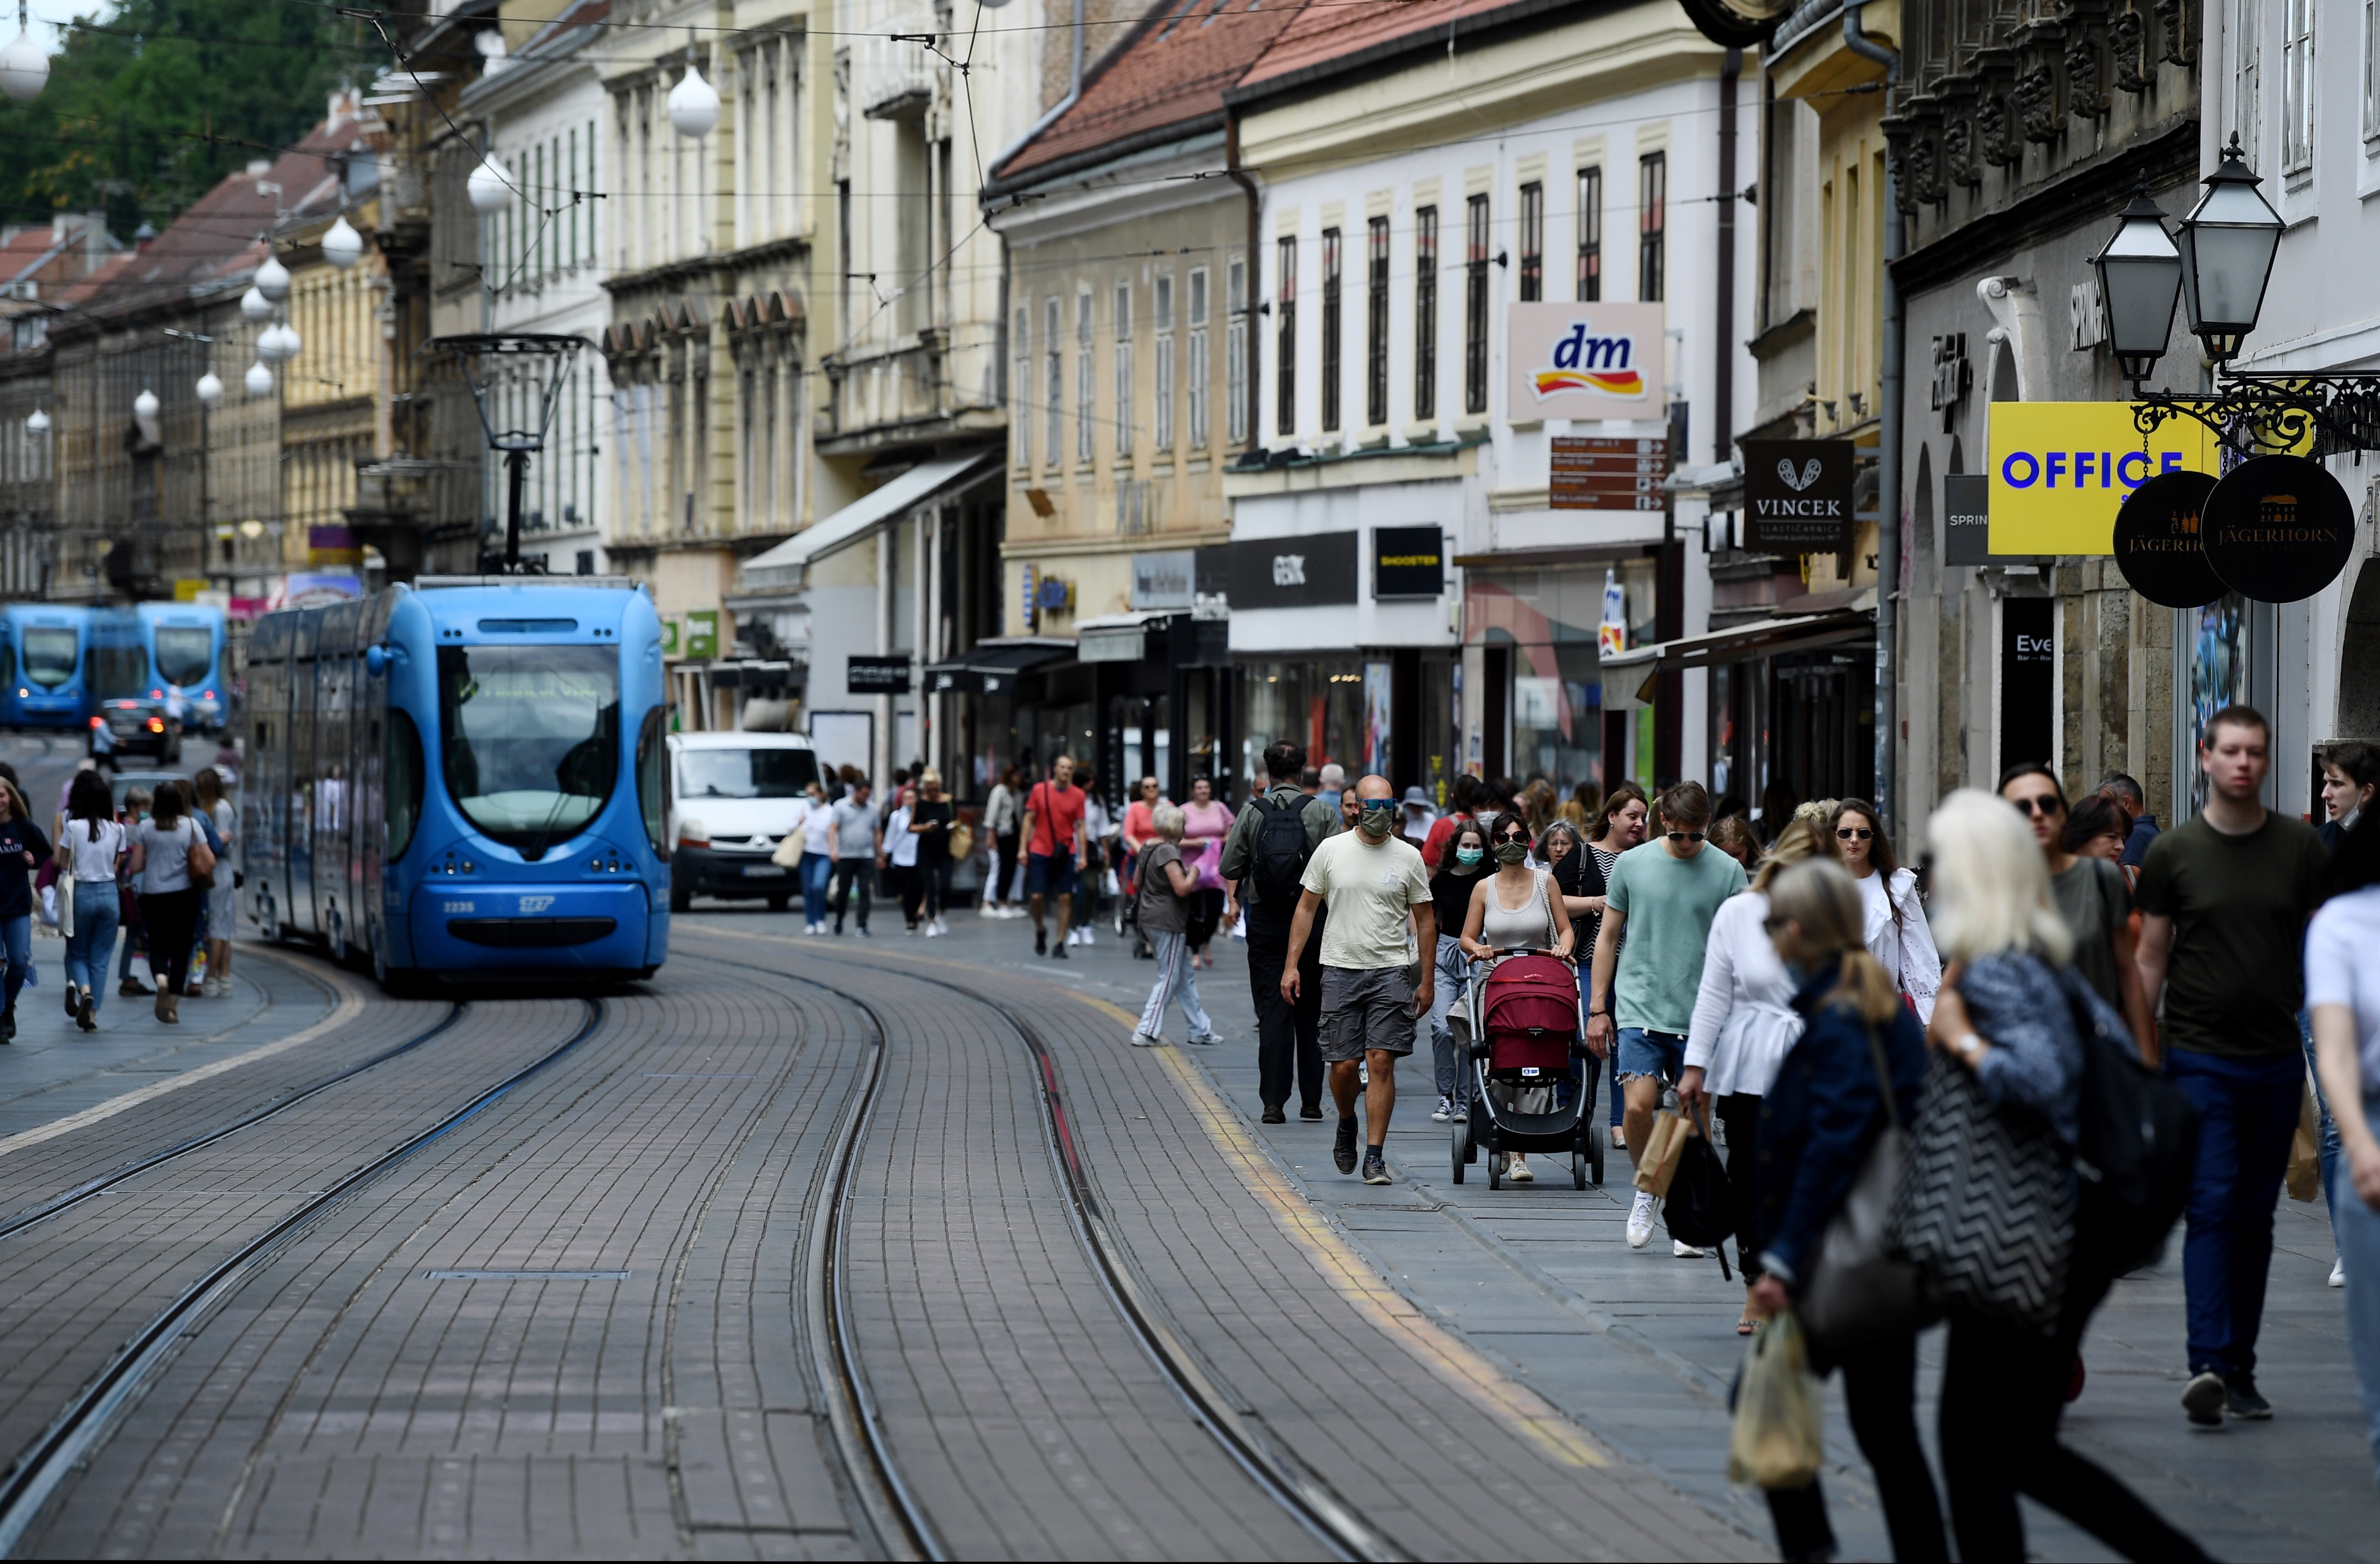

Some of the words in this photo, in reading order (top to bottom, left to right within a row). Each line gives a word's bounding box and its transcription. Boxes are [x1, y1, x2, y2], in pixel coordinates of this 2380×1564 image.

[1554, 324, 1630, 368] dm
[2002, 452, 2182, 489] OFFICE
[1756, 499, 1841, 516] VINCEK
[1950, 515, 1987, 526] SPRIN
[2218, 525, 2338, 546] JÄGERHORN
